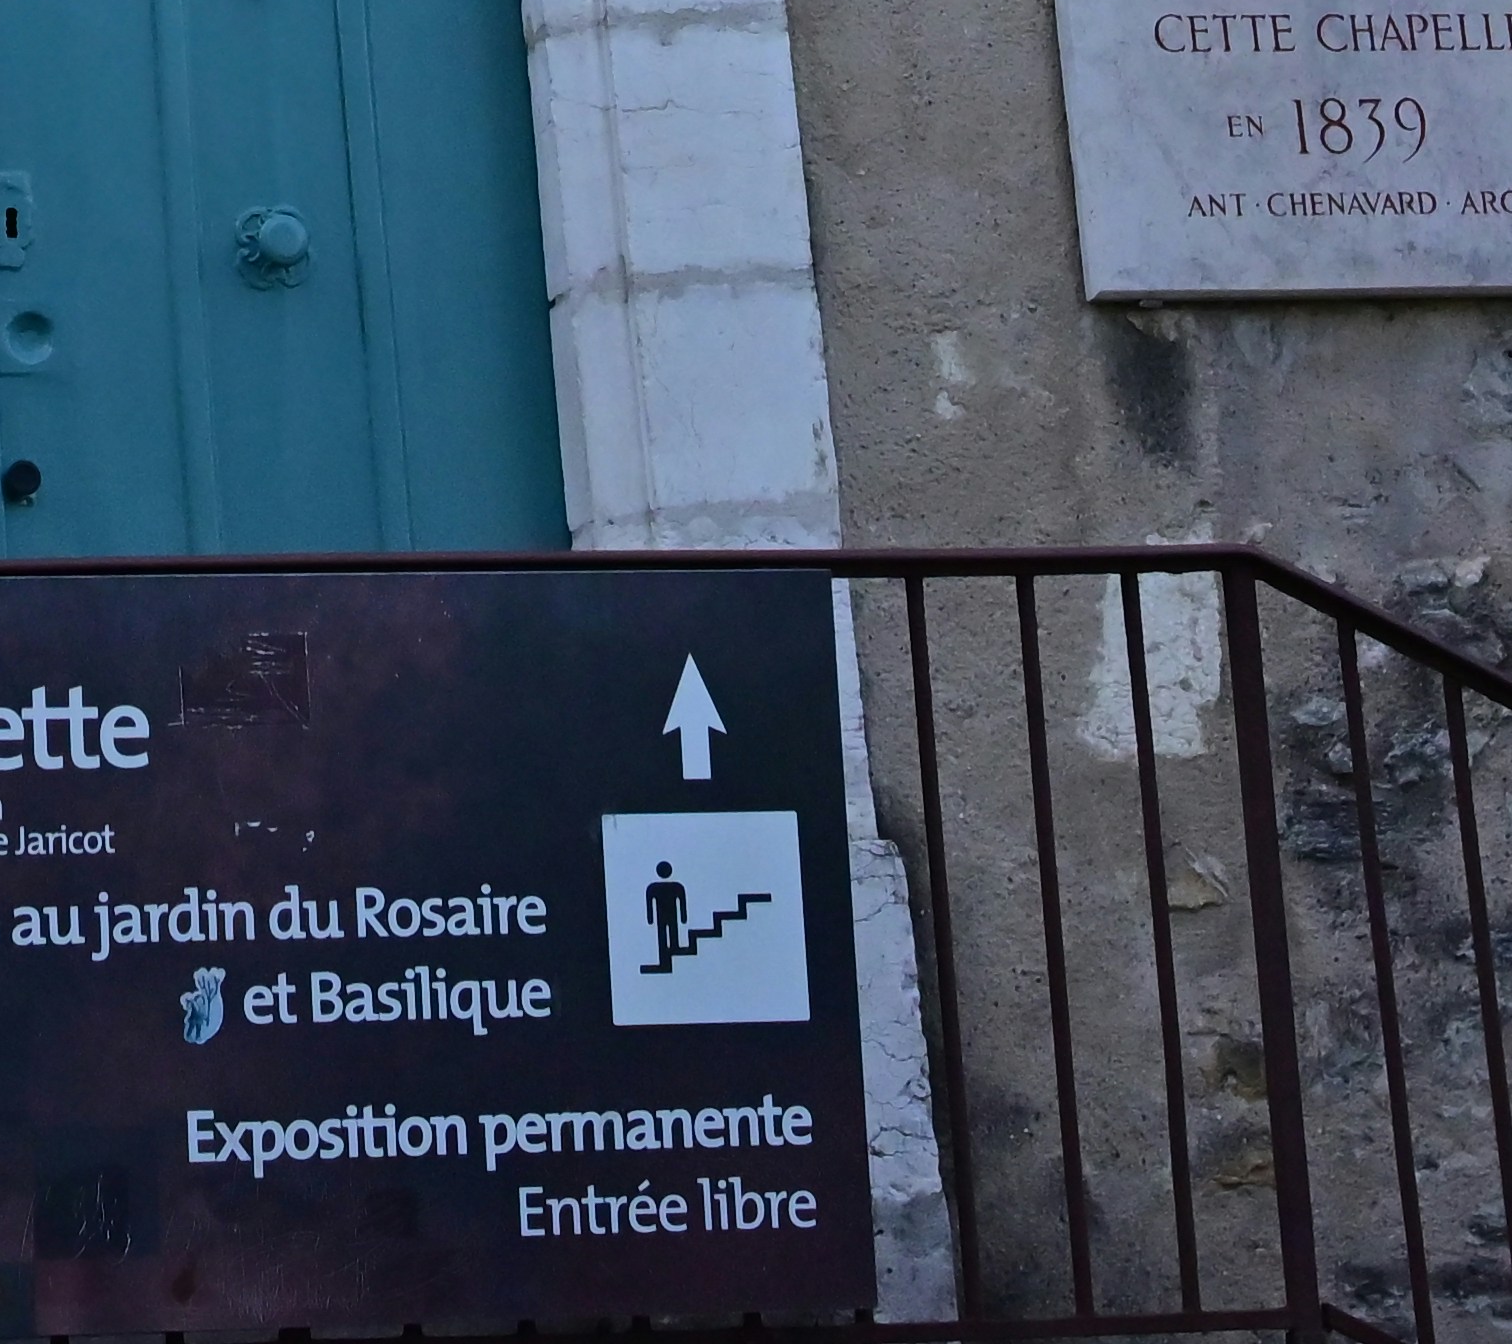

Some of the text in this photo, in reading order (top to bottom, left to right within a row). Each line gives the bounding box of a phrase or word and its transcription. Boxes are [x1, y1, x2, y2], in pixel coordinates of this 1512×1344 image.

[1153, 13, 1297, 54] CETTE
[1227, 96, 1428, 164] EN 1839
[1267, 190, 1437, 218] CHENAVARD
[13, 823, 116, 856] Jaricot
[11, 904, 86, 947] au
[91, 887, 255, 962] jardin
[269, 884, 345, 941] du
[355, 883, 548, 939] Rosaire
[243, 965, 552, 1037] et Basilique
[186, 1093, 814, 1179] Exposition permanente
[518, 1175, 818, 1238] Entrée libre
